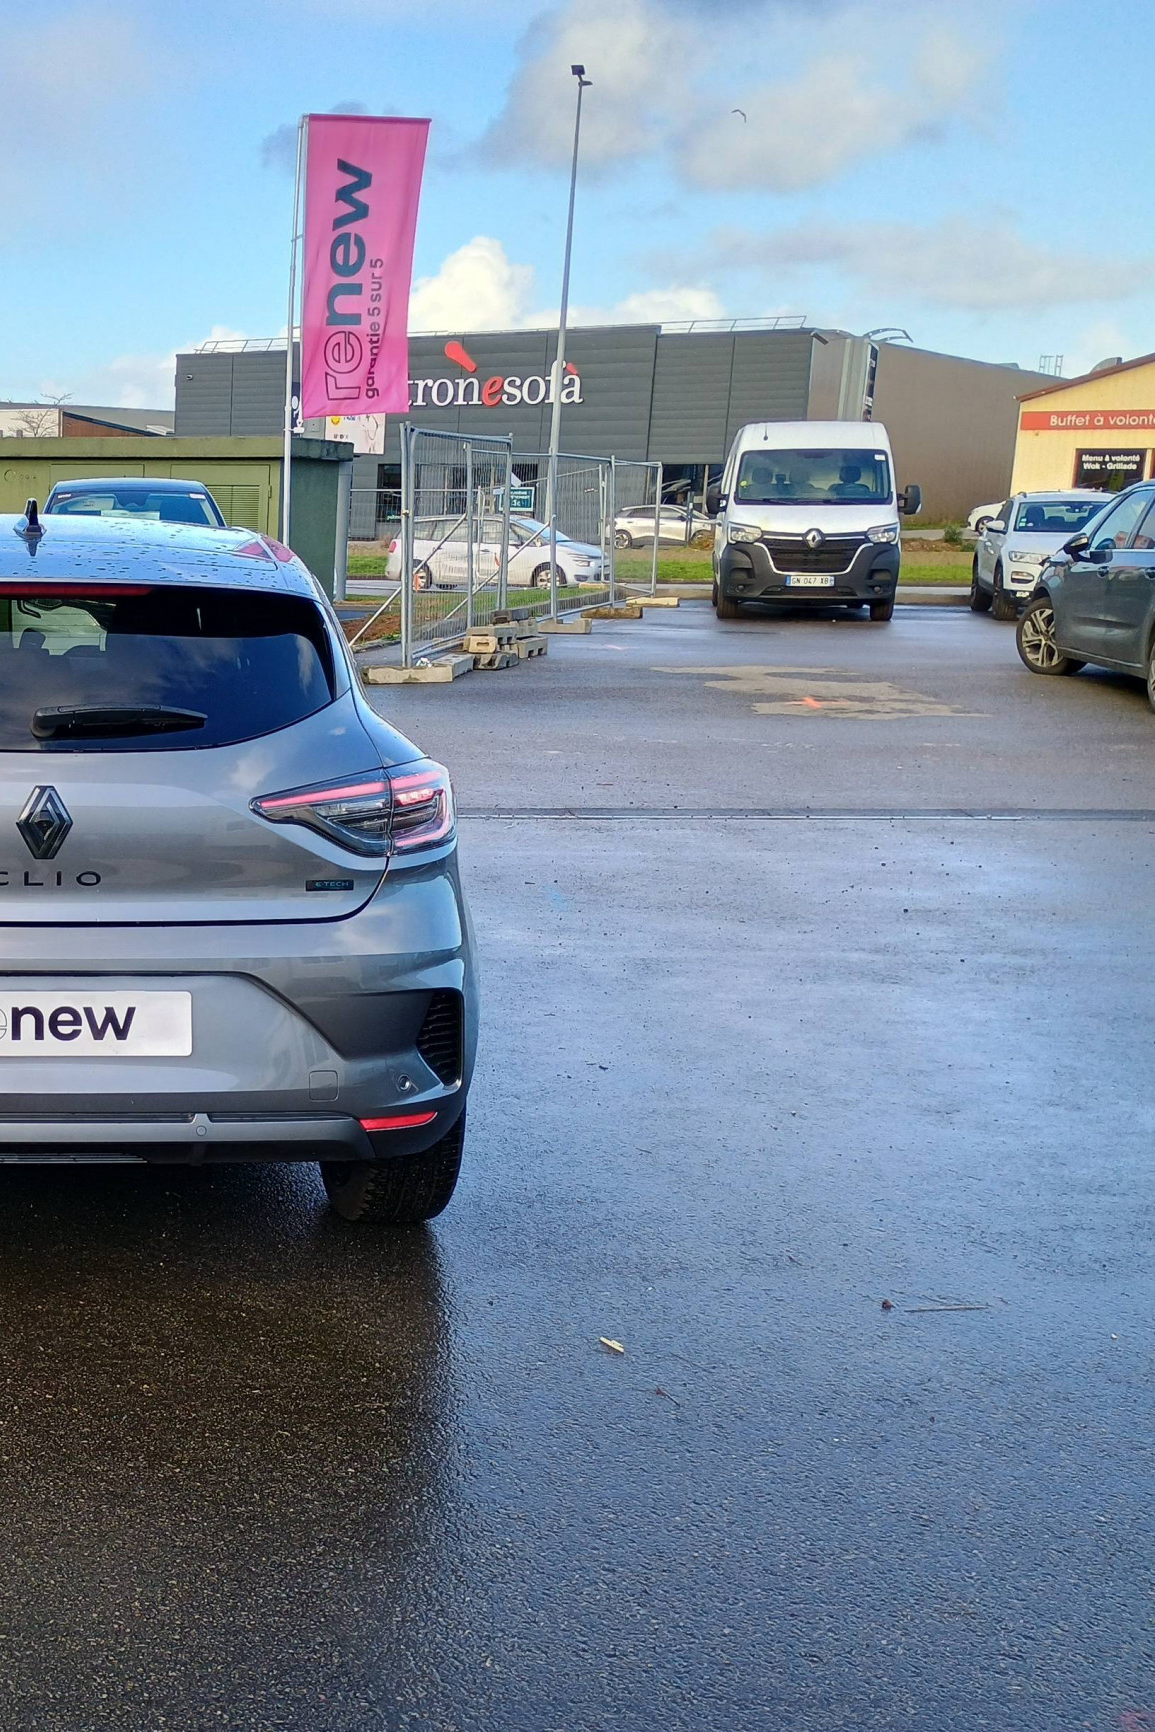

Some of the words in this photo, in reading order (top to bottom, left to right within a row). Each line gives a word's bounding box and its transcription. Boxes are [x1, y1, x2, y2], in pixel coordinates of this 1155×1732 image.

[370, 258, 383, 269] 5
[323, 158, 373, 401] renew
[370, 272, 383, 302] sur
[368, 306, 380, 317] 5
[365, 321, 381, 400] garantie
[1050, 415, 1090, 426] Buffet
[1094, 413, 1104, 425] à
[1083, 462, 1100, 470] Wok
